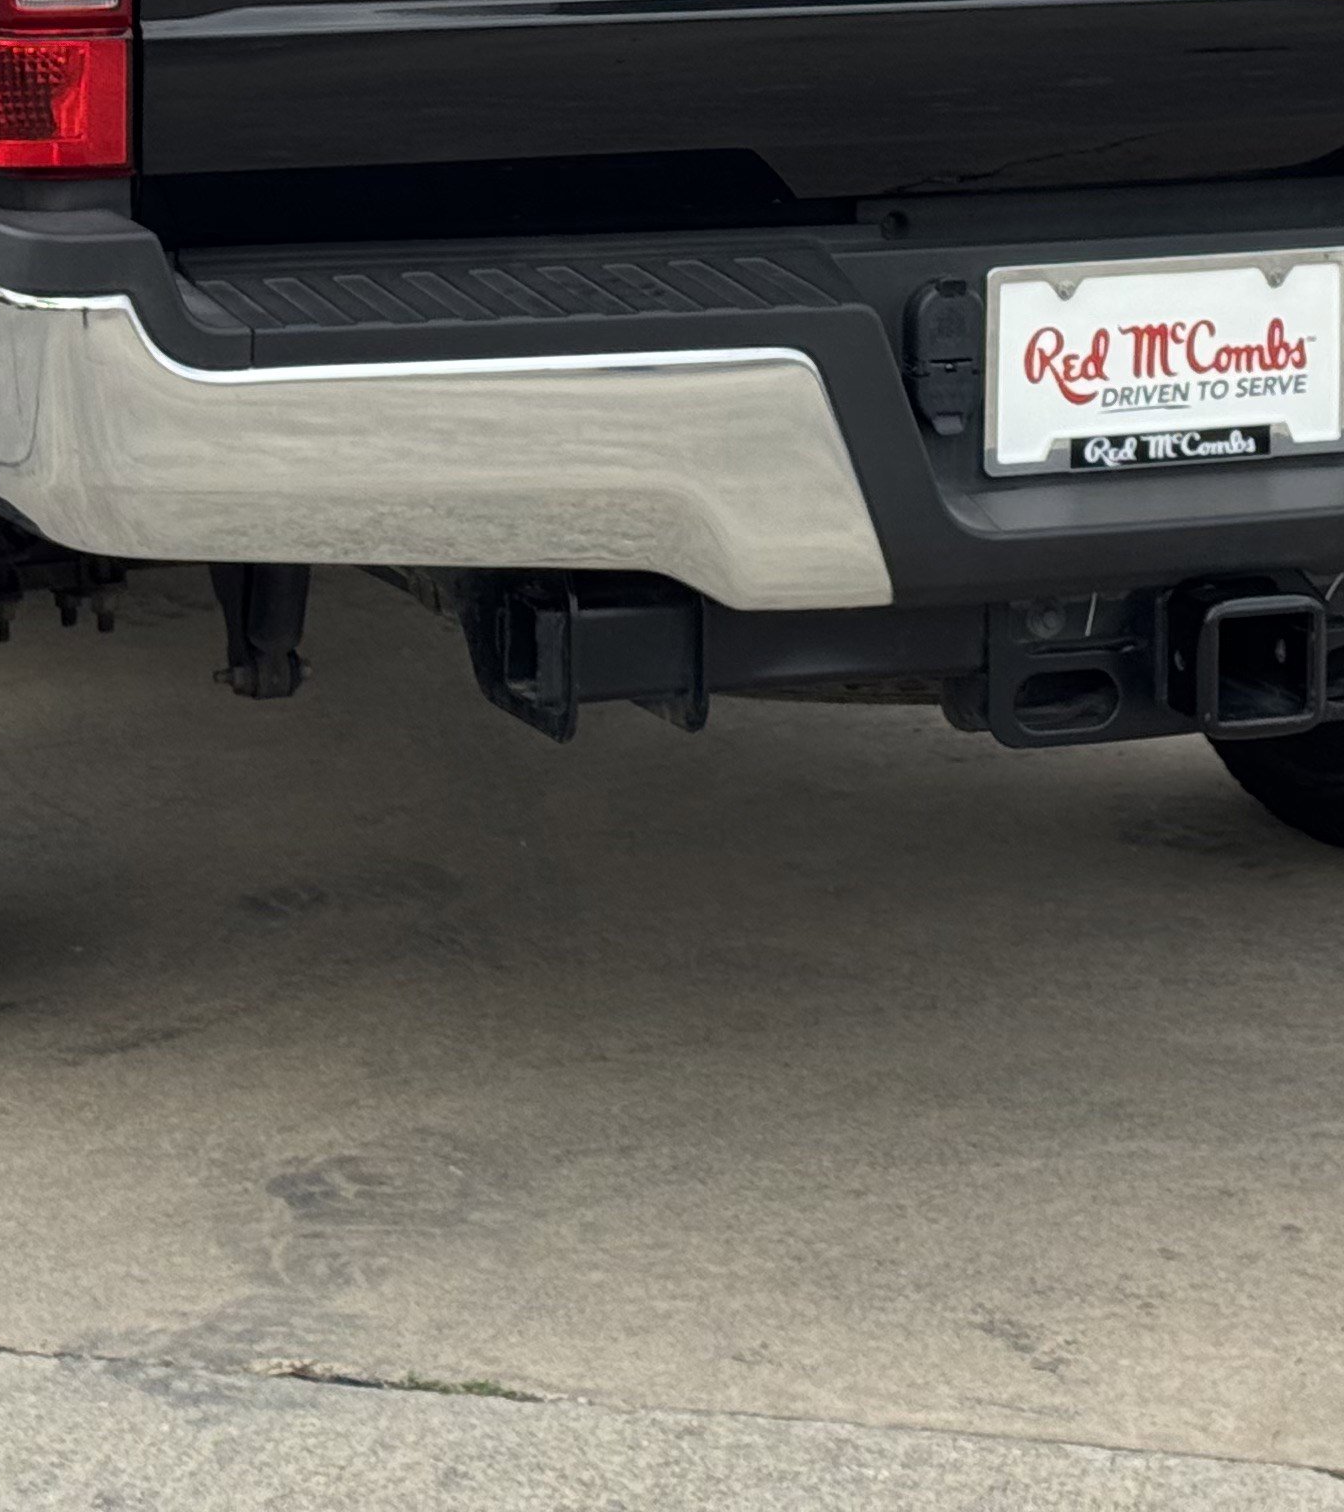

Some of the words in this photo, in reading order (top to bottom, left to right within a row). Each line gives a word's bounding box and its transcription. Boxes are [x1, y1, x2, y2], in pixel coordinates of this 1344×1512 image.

[1024, 326, 1110, 405] Red
[1118, 317, 1308, 377] McCombs
[1101, 381, 1190, 407] DRIVEN
[1197, 379, 1229, 401] TO
[1235, 374, 1308, 398] SERVE
[1084, 436, 1138, 467] Red
[1141, 429, 1257, 459] McCombs
